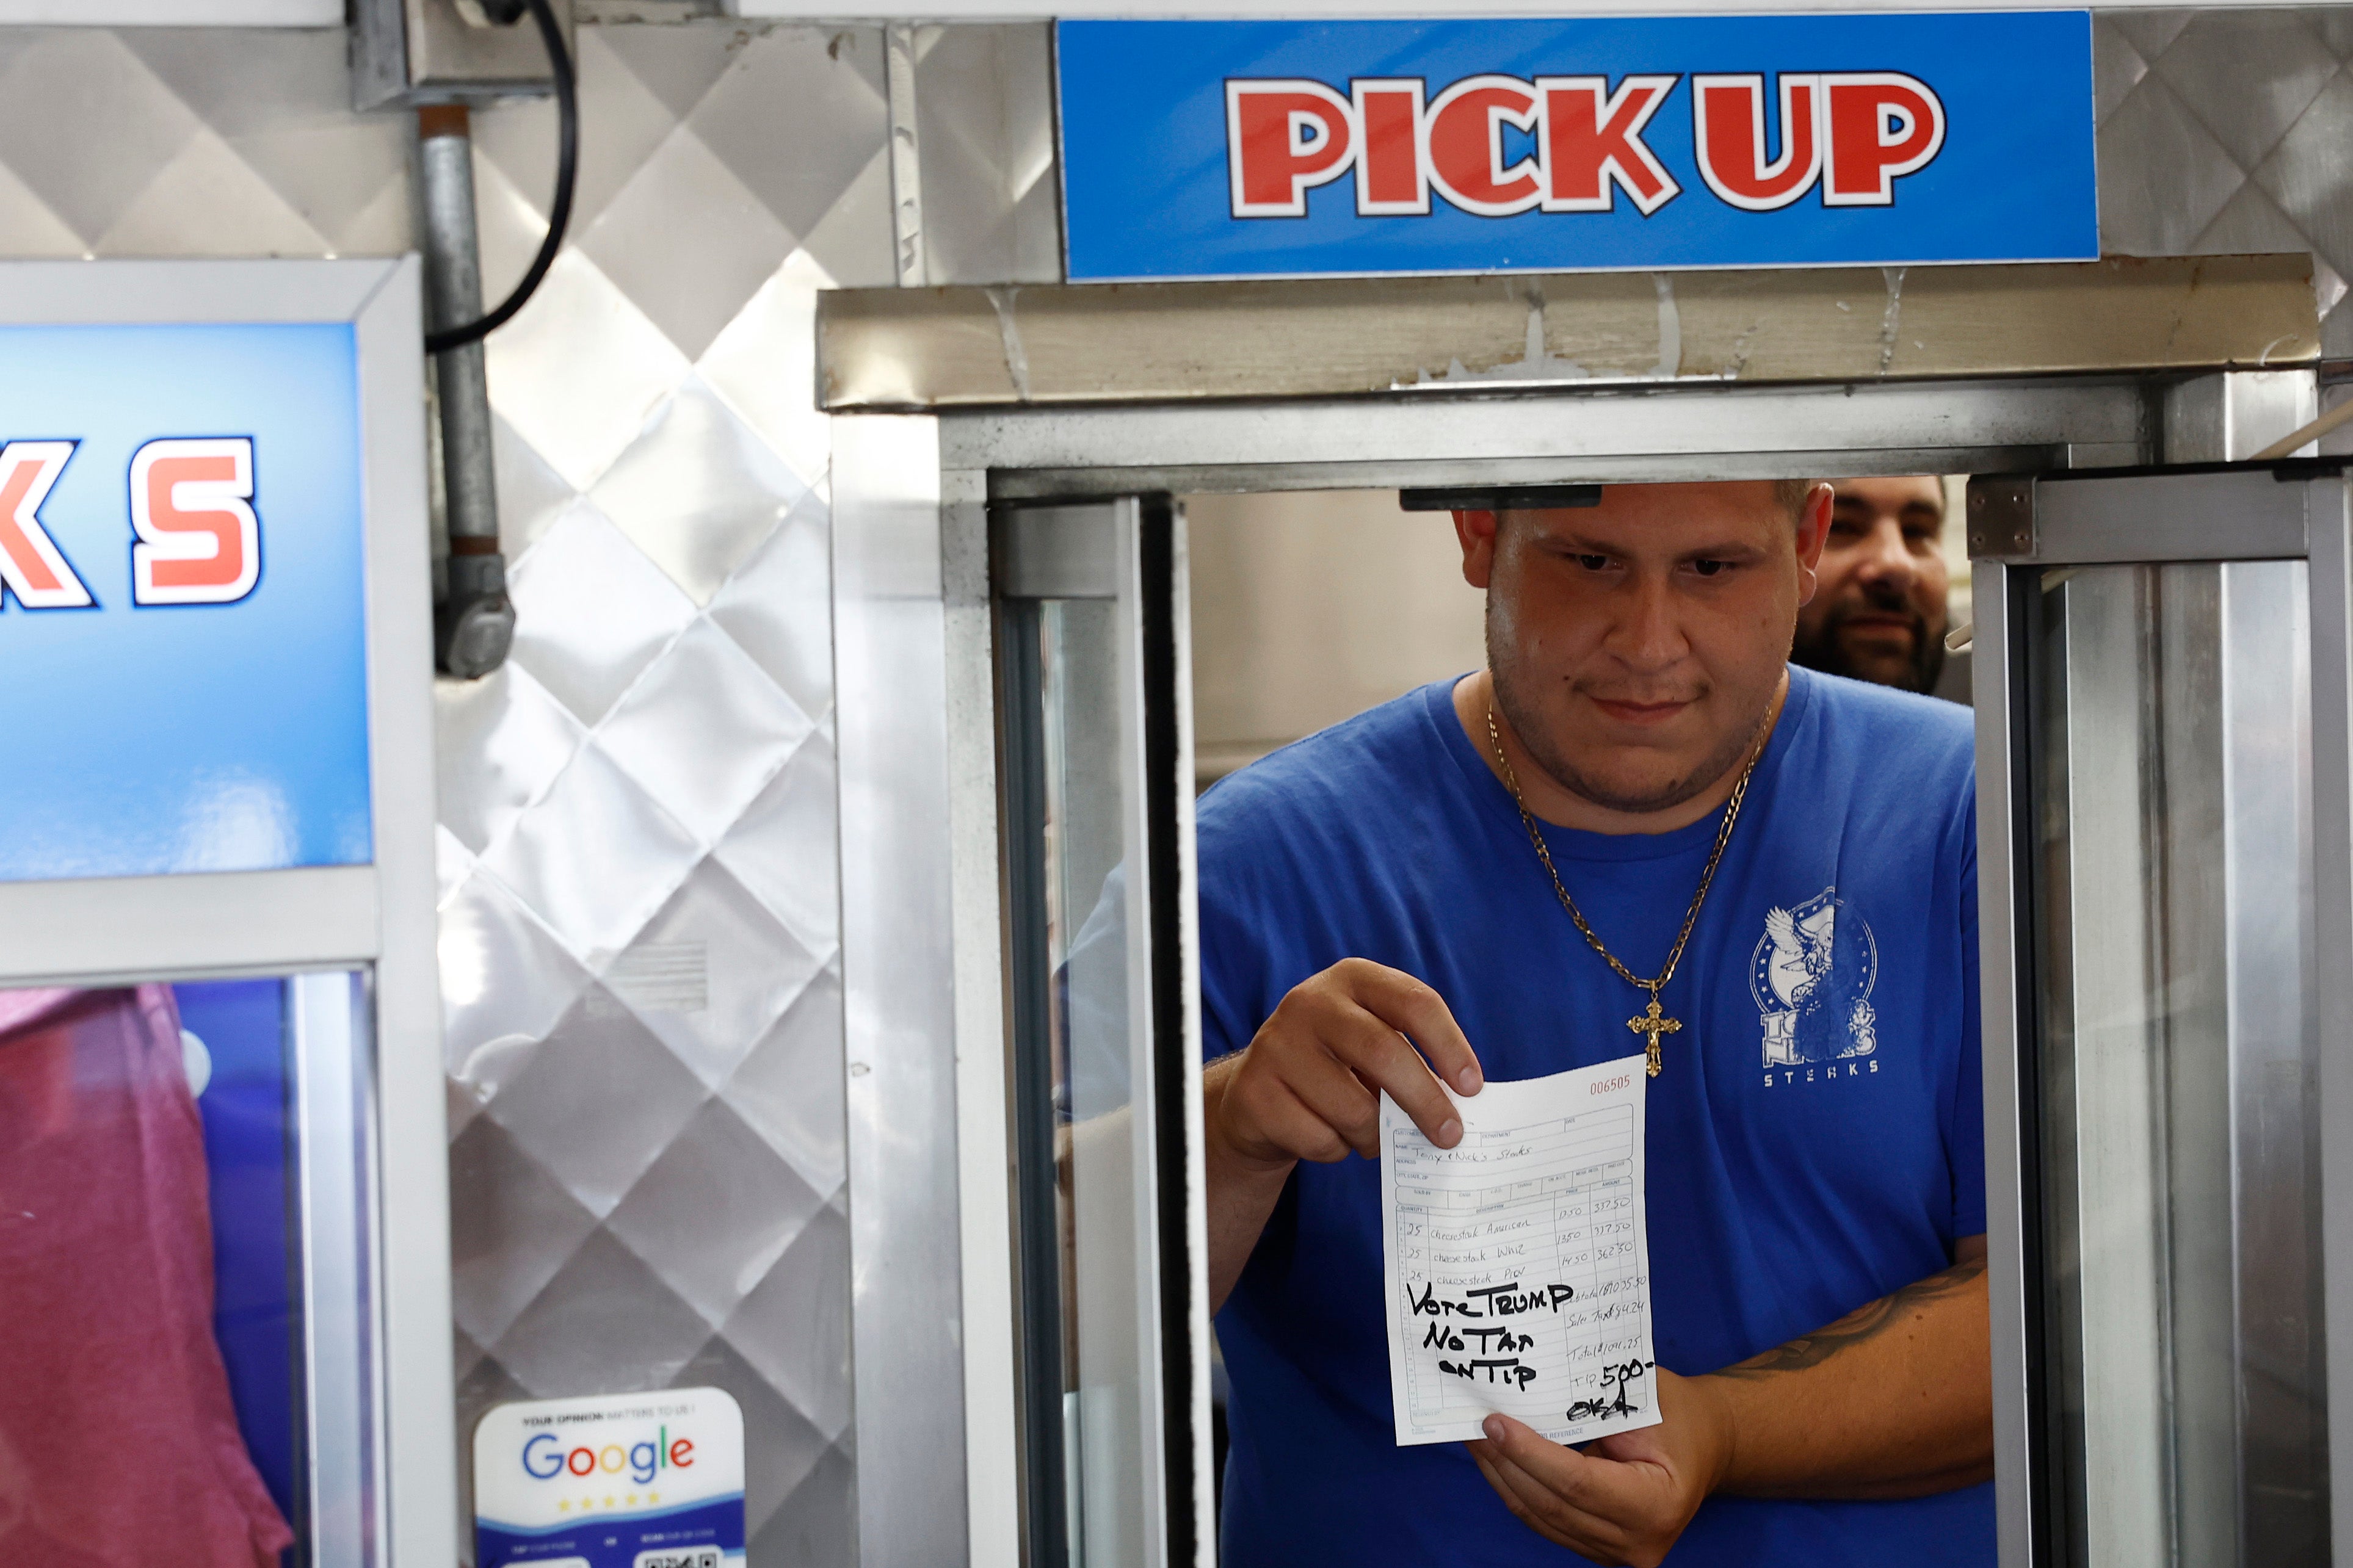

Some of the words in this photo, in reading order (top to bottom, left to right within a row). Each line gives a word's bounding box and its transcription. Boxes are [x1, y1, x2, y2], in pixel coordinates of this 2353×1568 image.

[1225, 73, 1683, 220] PICK
[1692, 71, 1945, 211] UP
[1764, 1060, 1879, 1087] STEAKS
[1590, 1075, 1630, 1095] 006505
[1407, 1223, 1423, 1236] 25
[1407, 1248, 1421, 1259] 25
[1410, 1270, 1423, 1281] 25
[1467, 1282, 1574, 1317] TRUMP
[1550, 1427, 1584, 1439] REFERENCE
[523, 1425, 694, 1484] Google
